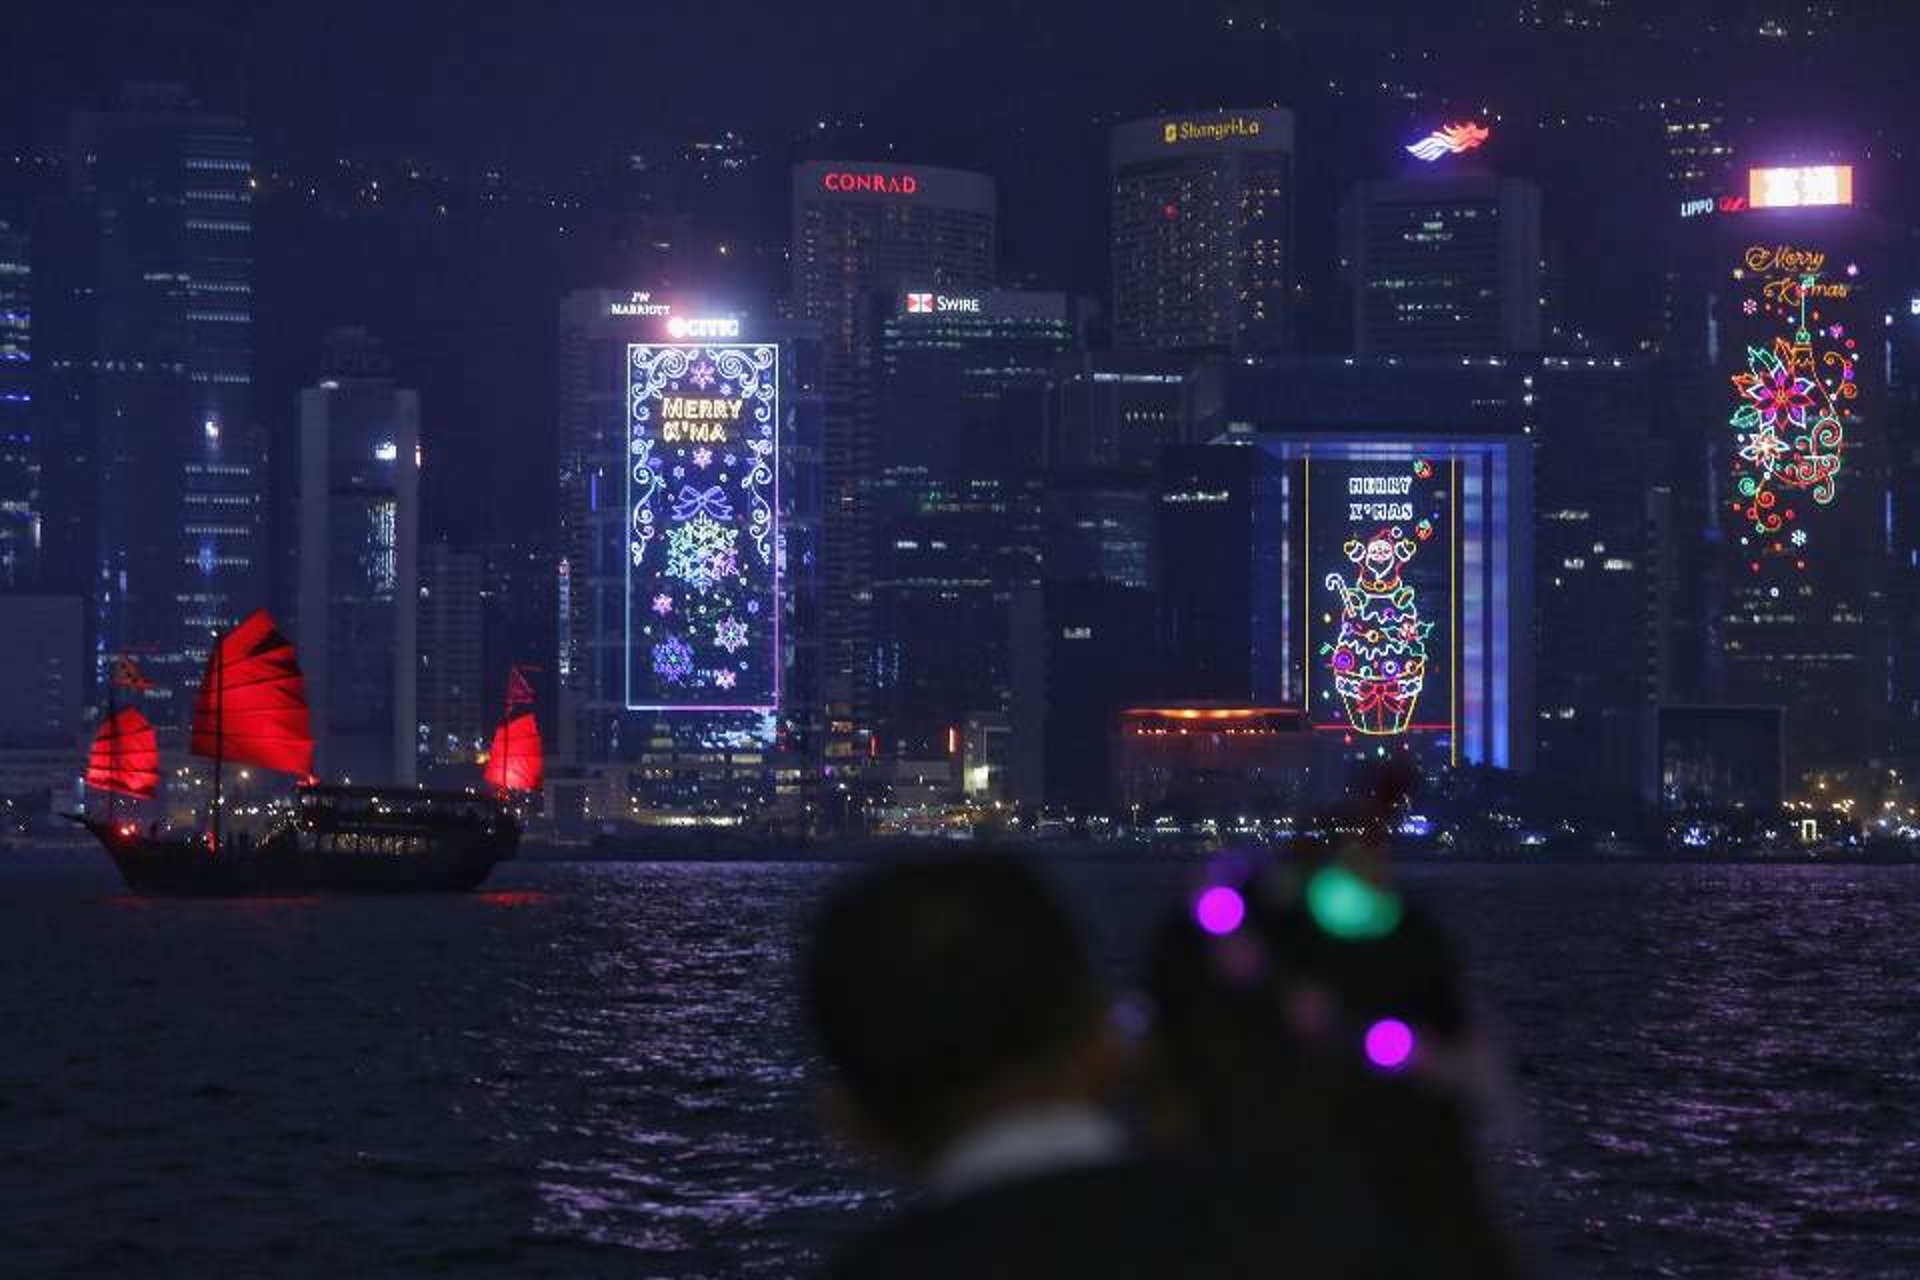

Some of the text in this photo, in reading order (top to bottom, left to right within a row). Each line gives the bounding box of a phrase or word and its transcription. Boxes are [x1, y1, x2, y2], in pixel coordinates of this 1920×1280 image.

[1180, 118, 1260, 141] Shangri-La
[824, 172, 917, 193] CONRAD
[1681, 197, 1713, 217] LIPPO
[1746, 245, 1825, 271] Merry
[1763, 277, 1848, 306] Xmas
[611, 304, 671, 315] MARRIOTT
[662, 397, 743, 419] MERRY
[1349, 476, 1412, 495] MERRY
[1349, 503, 1413, 521] X'MAS
